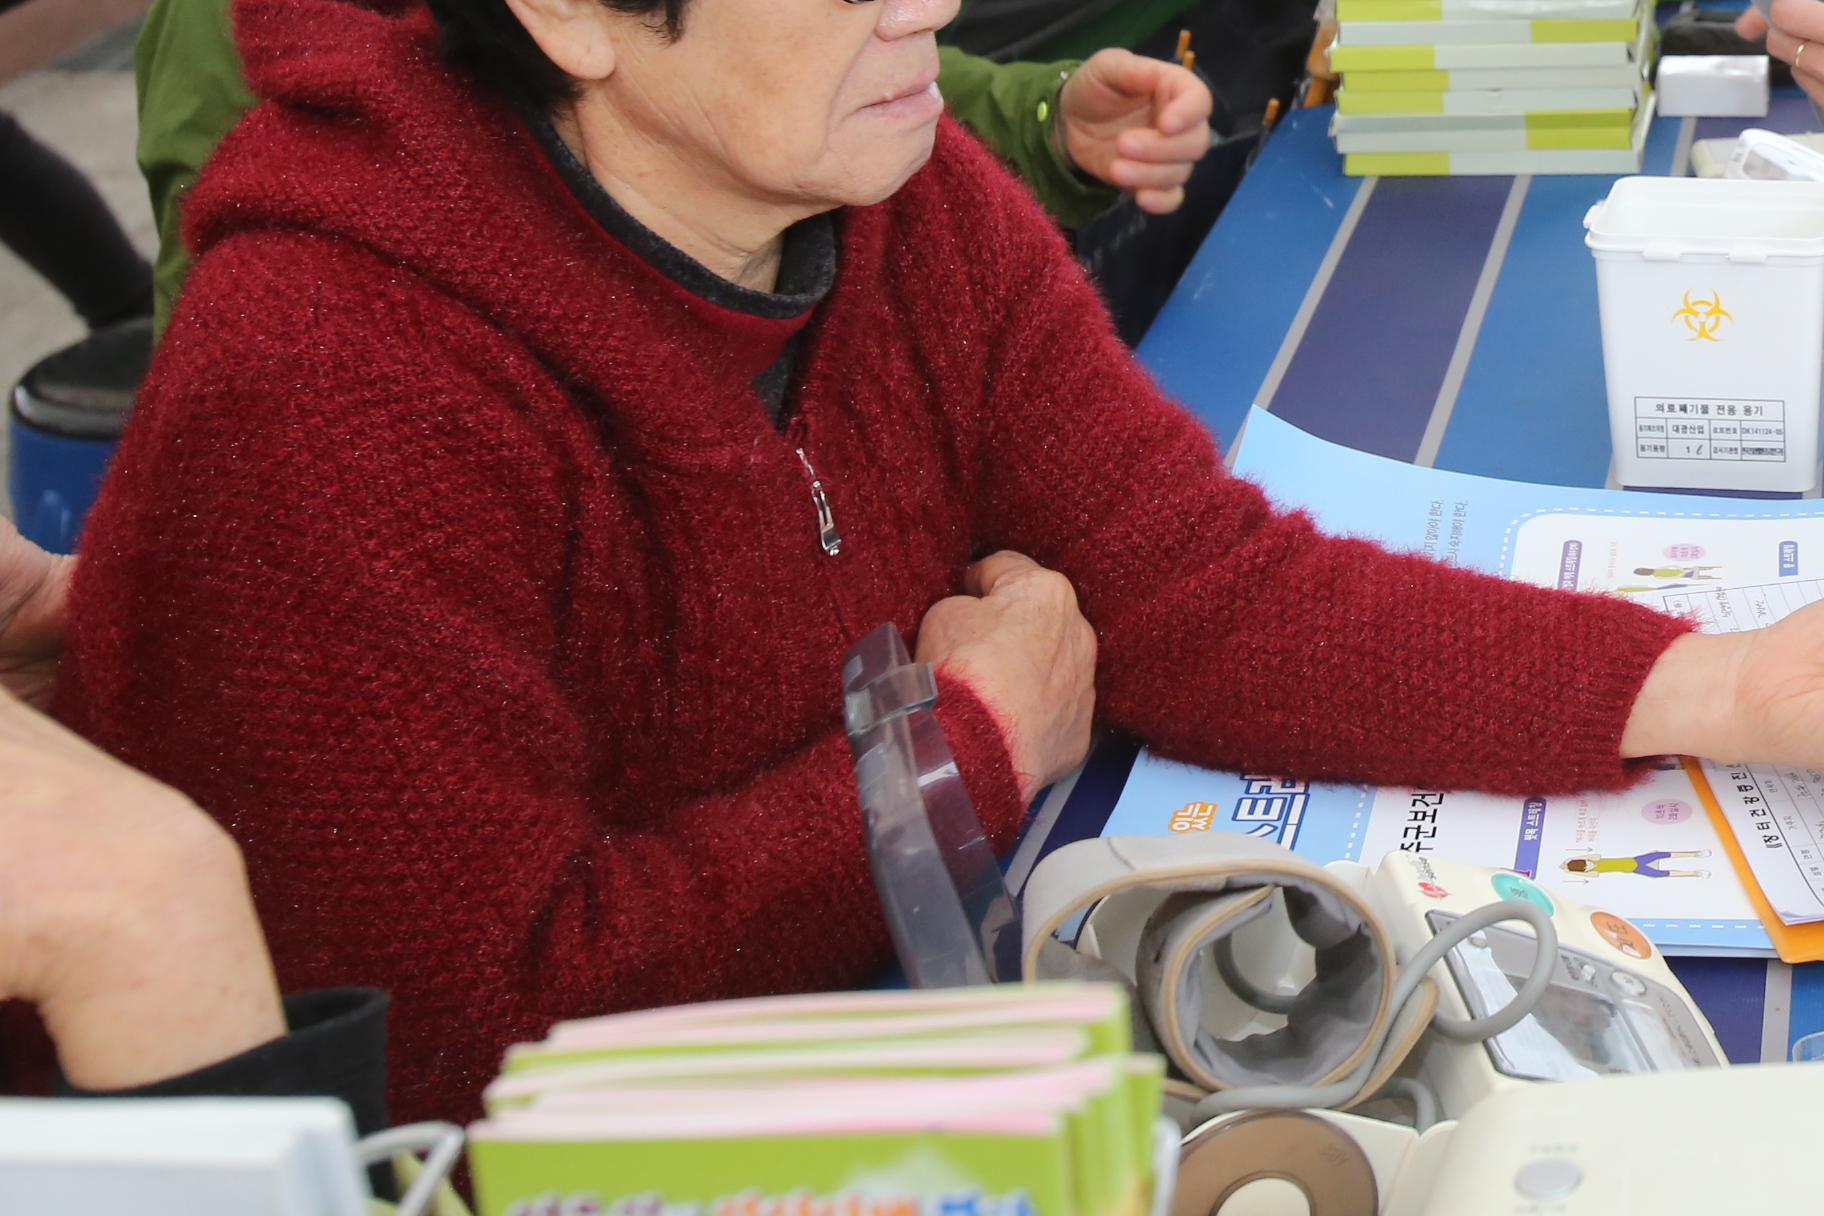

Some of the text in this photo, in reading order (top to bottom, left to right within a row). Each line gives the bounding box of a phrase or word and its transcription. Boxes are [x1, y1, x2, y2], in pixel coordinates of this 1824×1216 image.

[1655, 403, 1763, 417] 의료폐기물 전용 용기
[1672, 424, 1705, 435] 대광산업
[1171, 802, 1215, 832] 있는
[1525, 801, 1543, 827] 스트레칭
